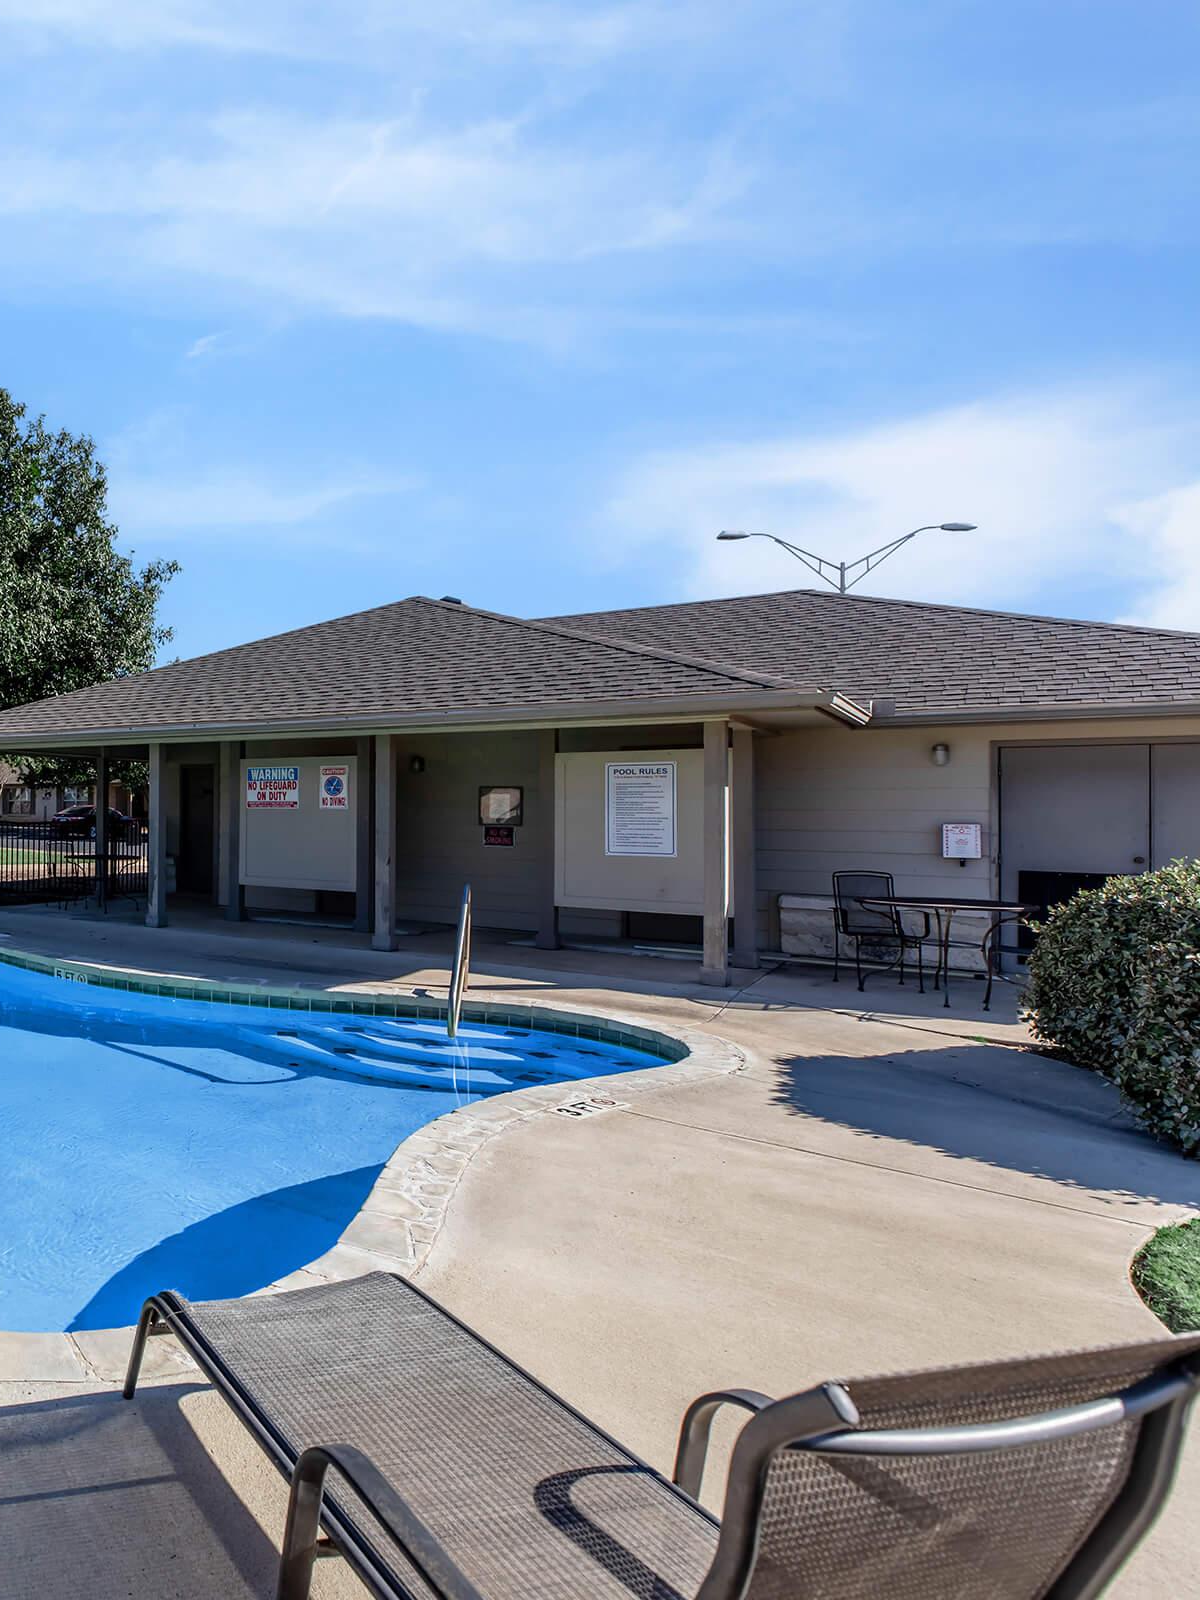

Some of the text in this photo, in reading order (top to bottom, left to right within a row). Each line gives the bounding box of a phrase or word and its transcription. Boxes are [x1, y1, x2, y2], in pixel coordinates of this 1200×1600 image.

[251, 768, 295, 780] WARNING
[639, 767, 668, 775] RULES
[248, 781, 297, 790] NO LIFEGUARD
[257, 791, 287, 800] ON DUTY
[556, 1101, 603, 1116] 3 FT
